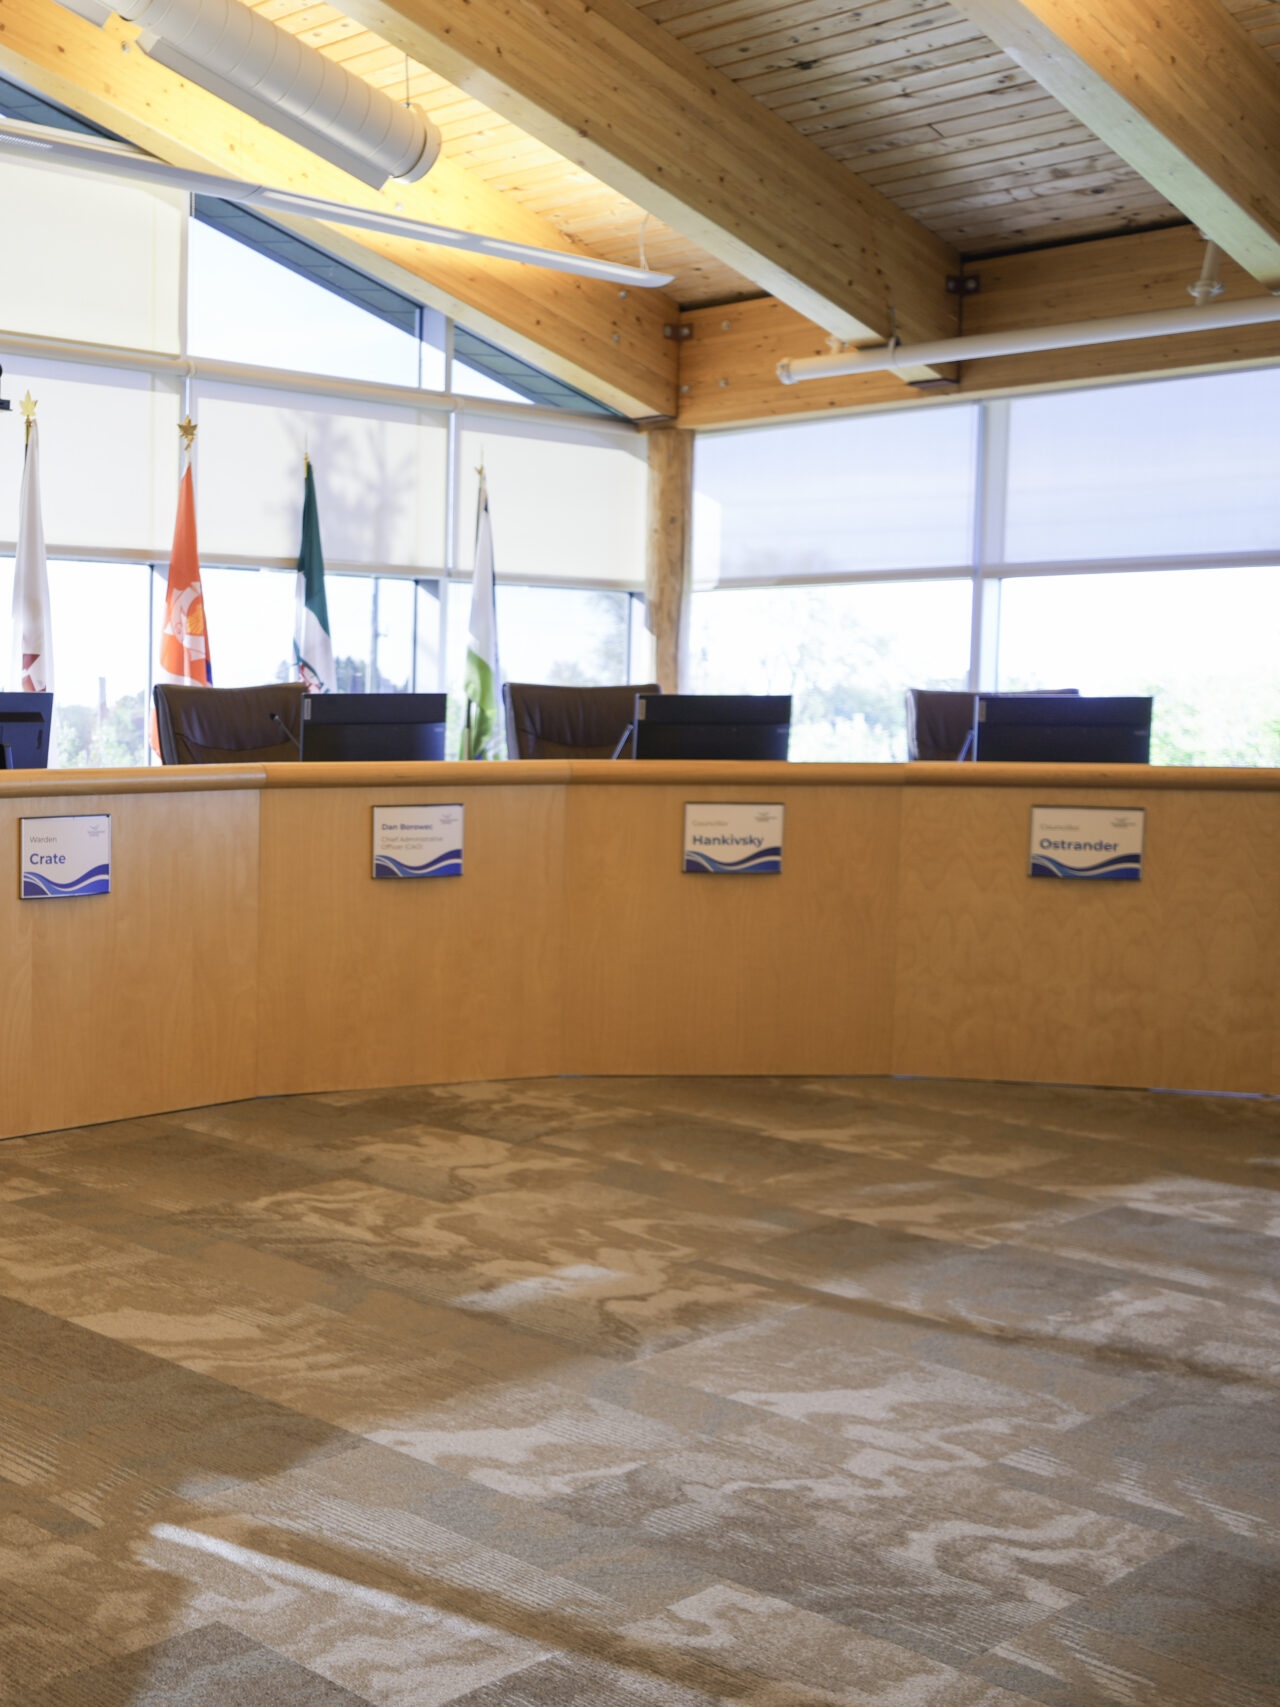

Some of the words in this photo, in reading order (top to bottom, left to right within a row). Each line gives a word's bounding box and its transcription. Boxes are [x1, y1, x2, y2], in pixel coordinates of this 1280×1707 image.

[29, 835, 58, 844] Warden
[692, 834, 764, 848] Hankivsky
[1039, 838, 1119, 851] Ostrander
[29, 852, 66, 865] Crate
